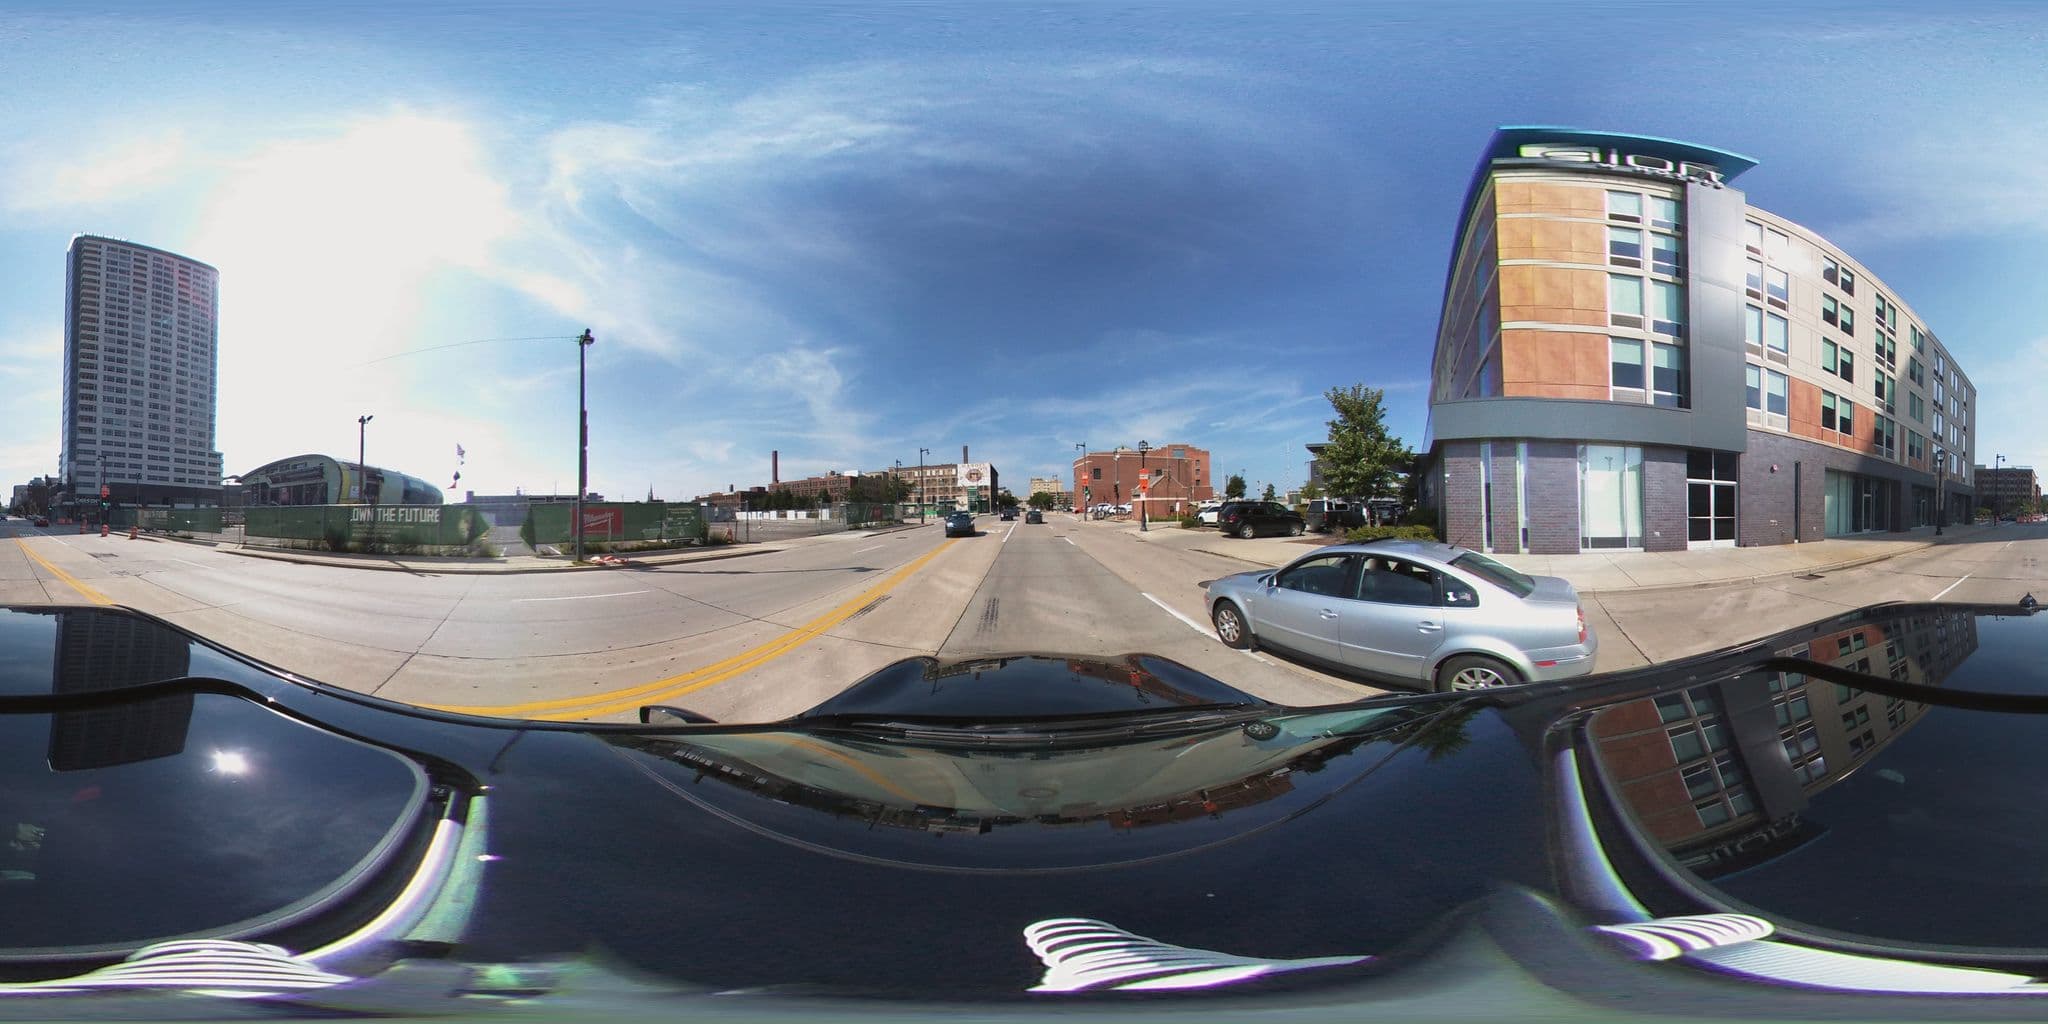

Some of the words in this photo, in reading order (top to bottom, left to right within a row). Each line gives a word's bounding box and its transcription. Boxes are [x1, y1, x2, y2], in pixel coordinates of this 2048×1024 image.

[352, 508, 375, 522] OWN
[377, 508, 396, 522] THE
[398, 508, 440, 523] FUTURE
